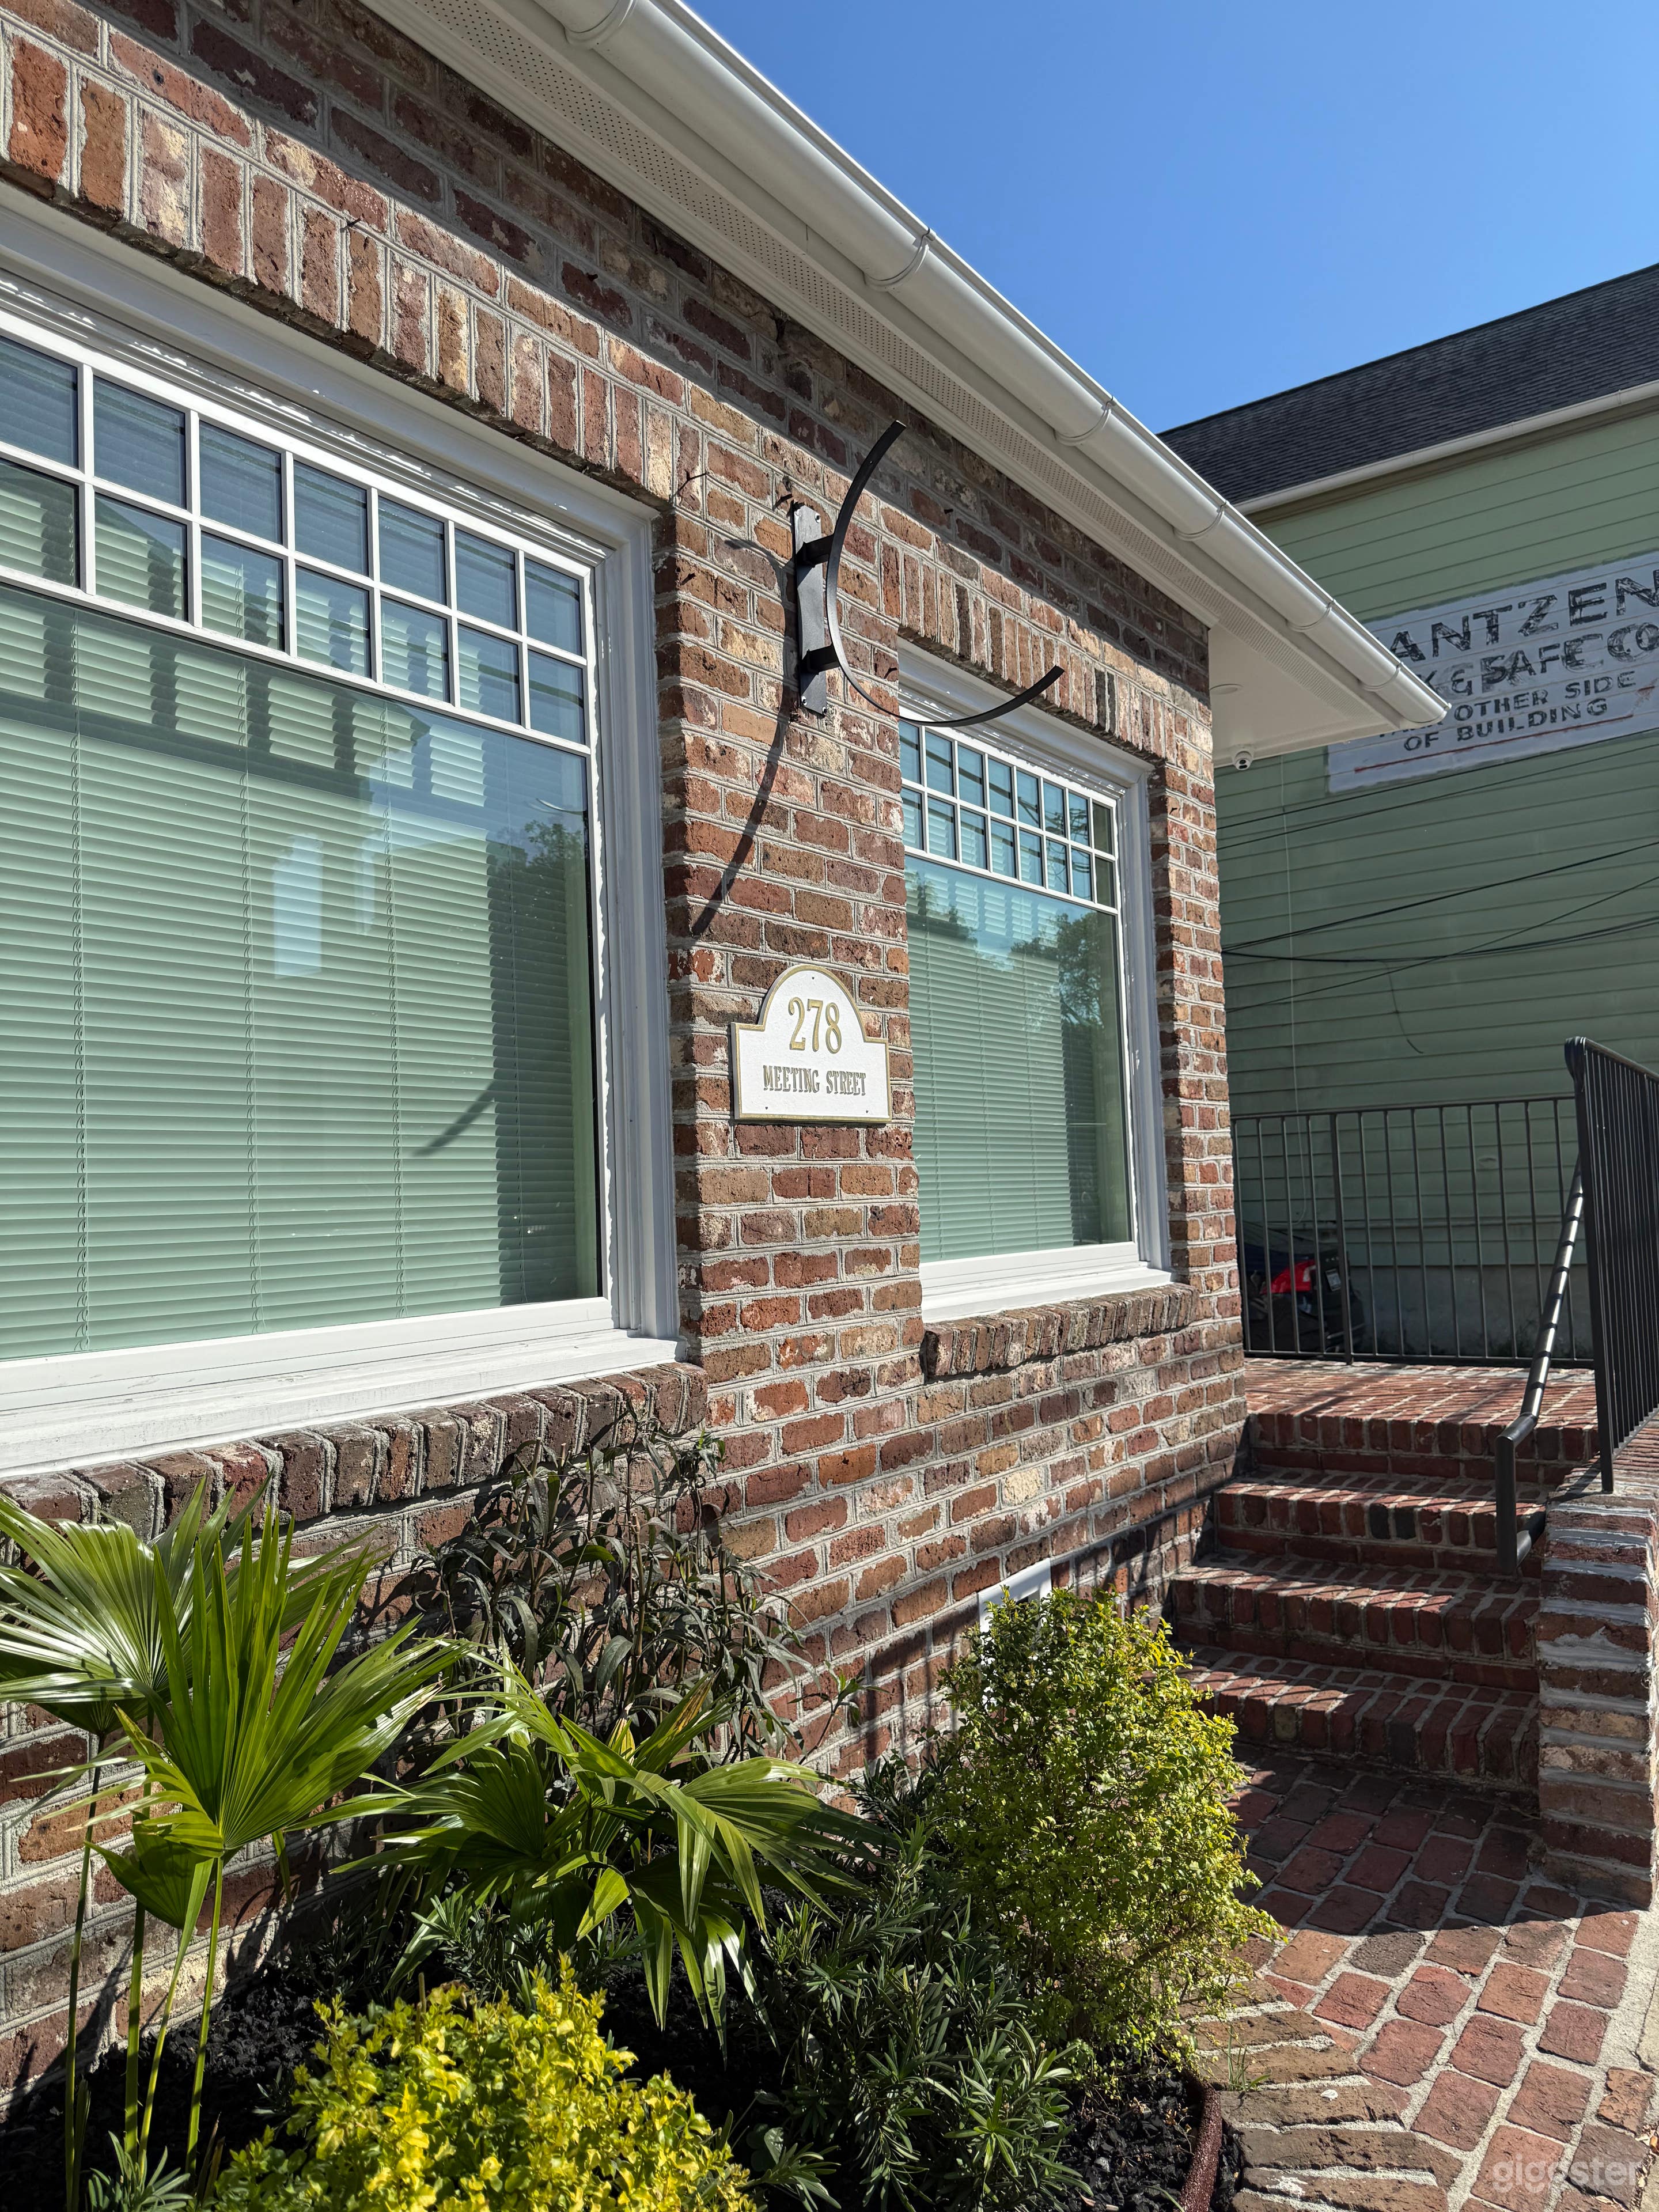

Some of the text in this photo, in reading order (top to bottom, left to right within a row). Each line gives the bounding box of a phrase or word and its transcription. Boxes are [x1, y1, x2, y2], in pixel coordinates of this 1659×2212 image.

[1377, 570, 1659, 661] ANTZEN
[1451, 669, 1473, 696] &
[1481, 634, 1604, 685] SAFE
[1454, 671, 1636, 721] OTHER SIDE
[1404, 731, 1439, 751] OF
[1457, 698, 1607, 741] BUILDING
[788, 997, 842, 1054] 278
[763, 1065, 866, 1096] MEETING STREET
